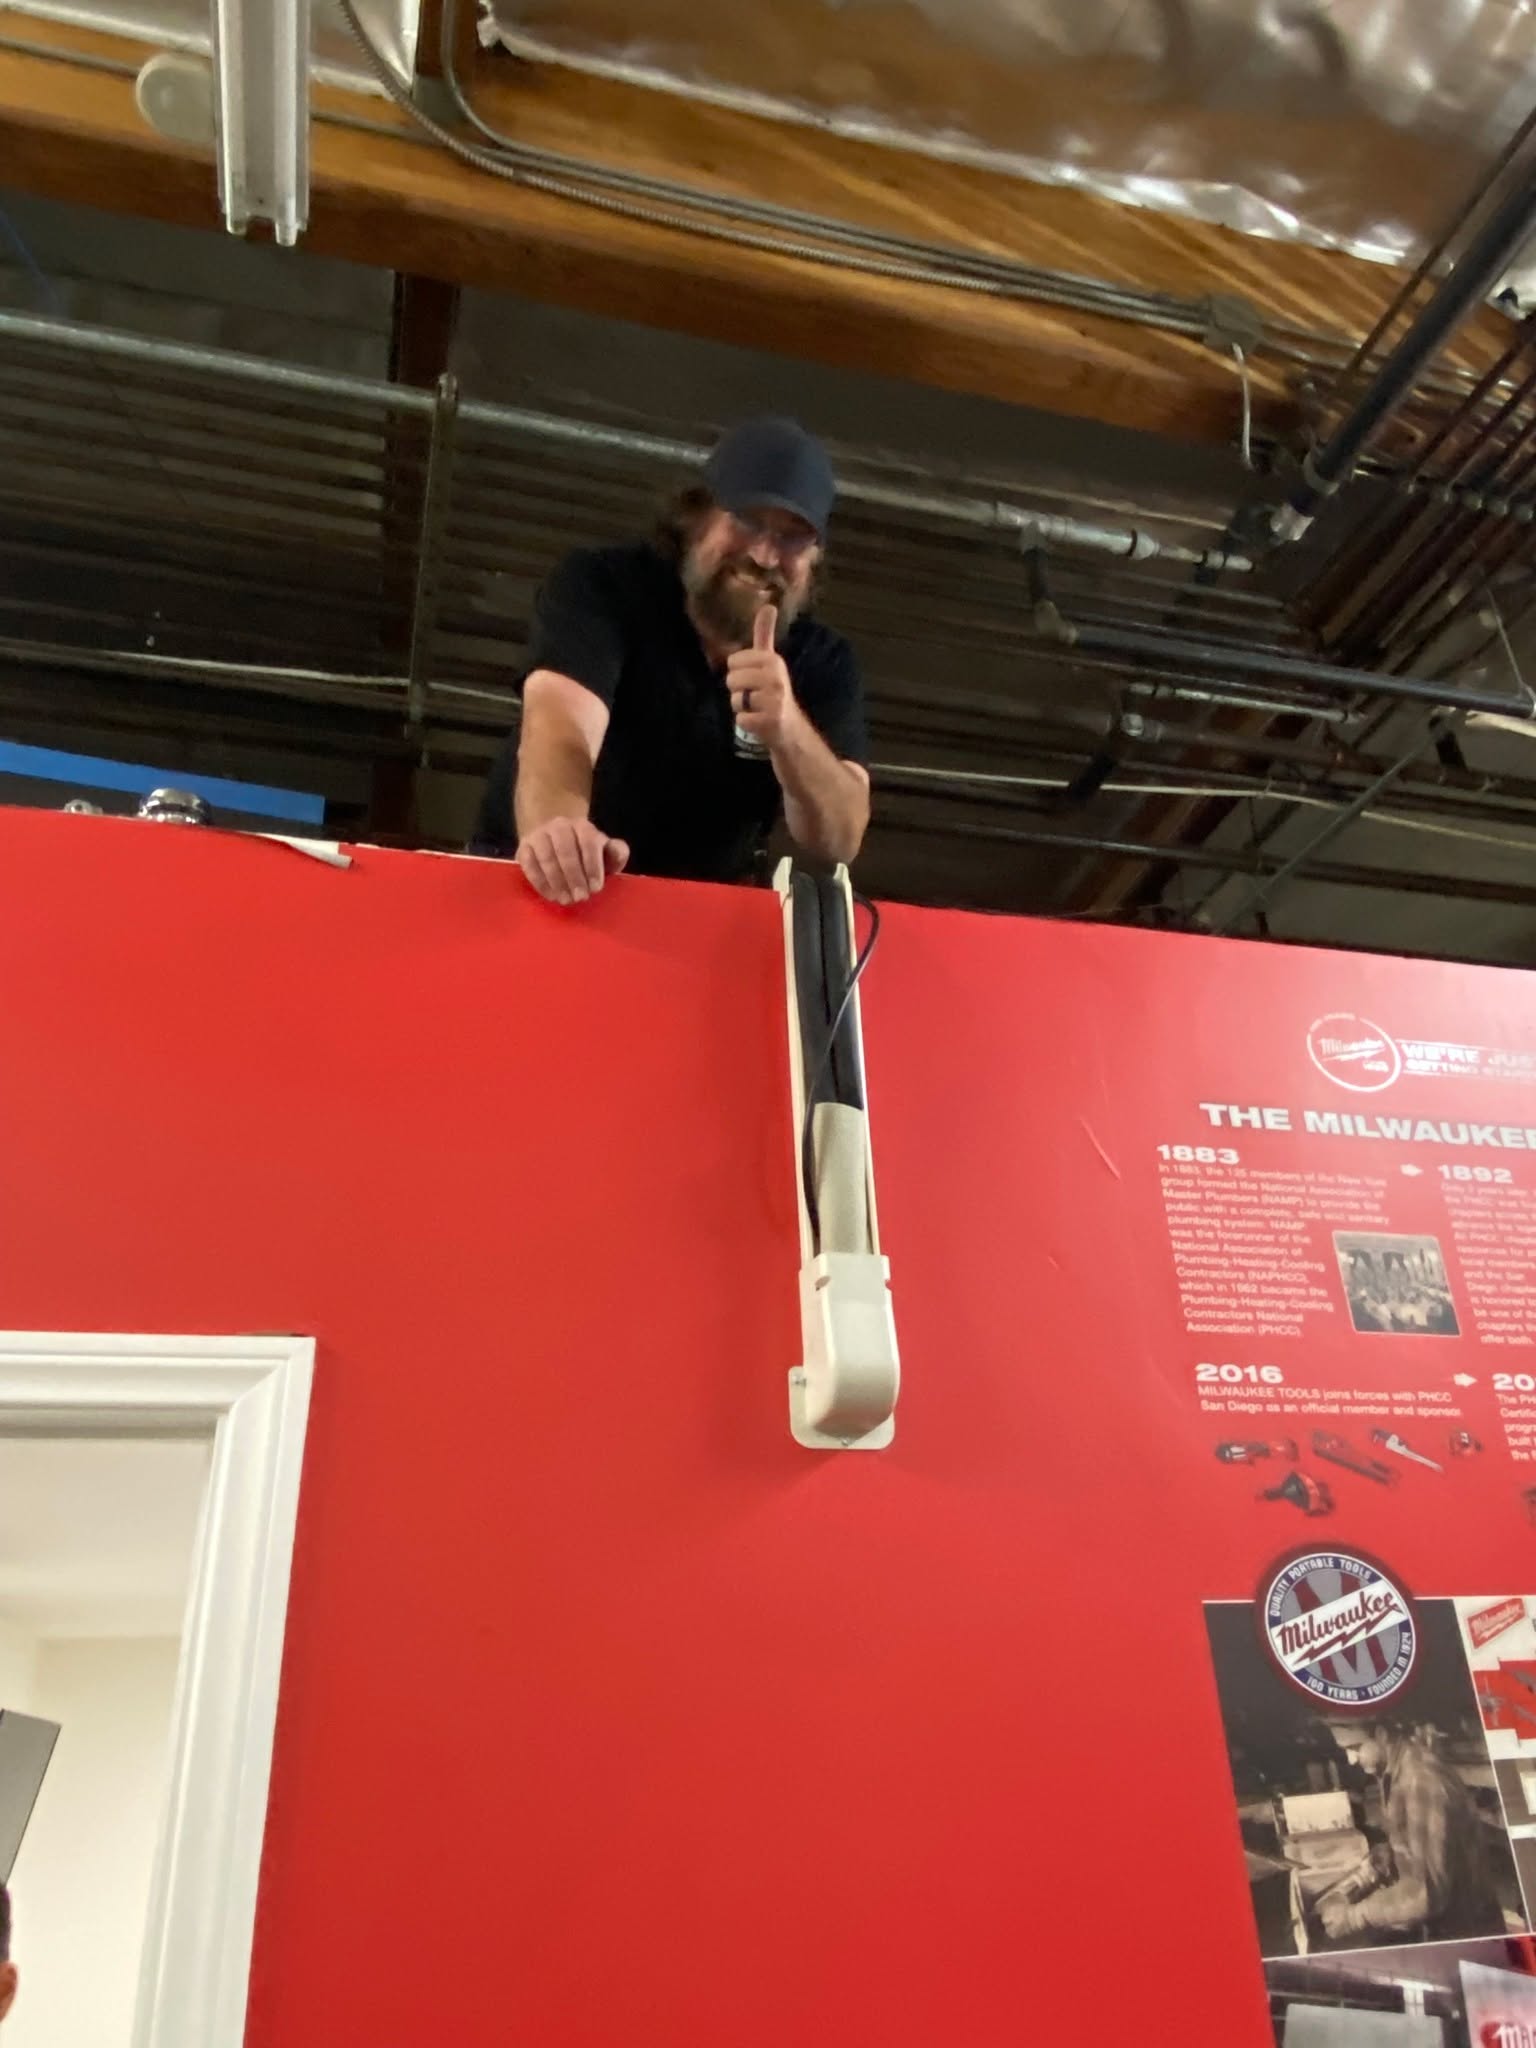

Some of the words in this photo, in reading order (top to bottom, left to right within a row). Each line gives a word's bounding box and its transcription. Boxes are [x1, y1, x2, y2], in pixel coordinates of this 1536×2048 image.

[1200, 1102, 1293, 1131] THE
[1157, 1144, 1240, 1165] 1883
[1437, 1164, 1514, 1184] 1892
[1167, 1215, 1222, 1229] plumbing
[1171, 1240, 1220, 1253] National
[1176, 1266, 1246, 1281] Contractors
[1183, 1307, 1254, 1322] Contractors
[1255, 1310, 1305, 1324] National
[1186, 1321, 1256, 1335] Association
[1195, 1363, 1284, 1384] 2016
[1198, 1385, 1276, 1399] MILWAUKEE
[1277, 1387, 1322, 1400] TOOLS
[1322, 1388, 1352, 1403] joins
[1353, 1388, 1390, 1402] forces
[1391, 1391, 1417, 1402] with
[1417, 1391, 1453, 1403] PHCC
[1200, 1399, 1226, 1412] San
[1227, 1400, 1264, 1415] Diego
[1301, 1402, 1341, 1415] official
[1342, 1405, 1390, 1416] member
[1392, 1406, 1416, 1416] and
[1270, 1580, 1289, 1617] QUALITY
[1287, 1557, 1335, 1581] PORTABLE
[1339, 1558, 1373, 1580] TOOLS
[1275, 1590, 1404, 1656] Milwaukee
[1306, 1676, 1325, 1693] 100
[1327, 1686, 1359, 1701] YEARS
[1367, 1668, 1403, 1698] FOUNDED
[1401, 1631, 1412, 1655] 1924
